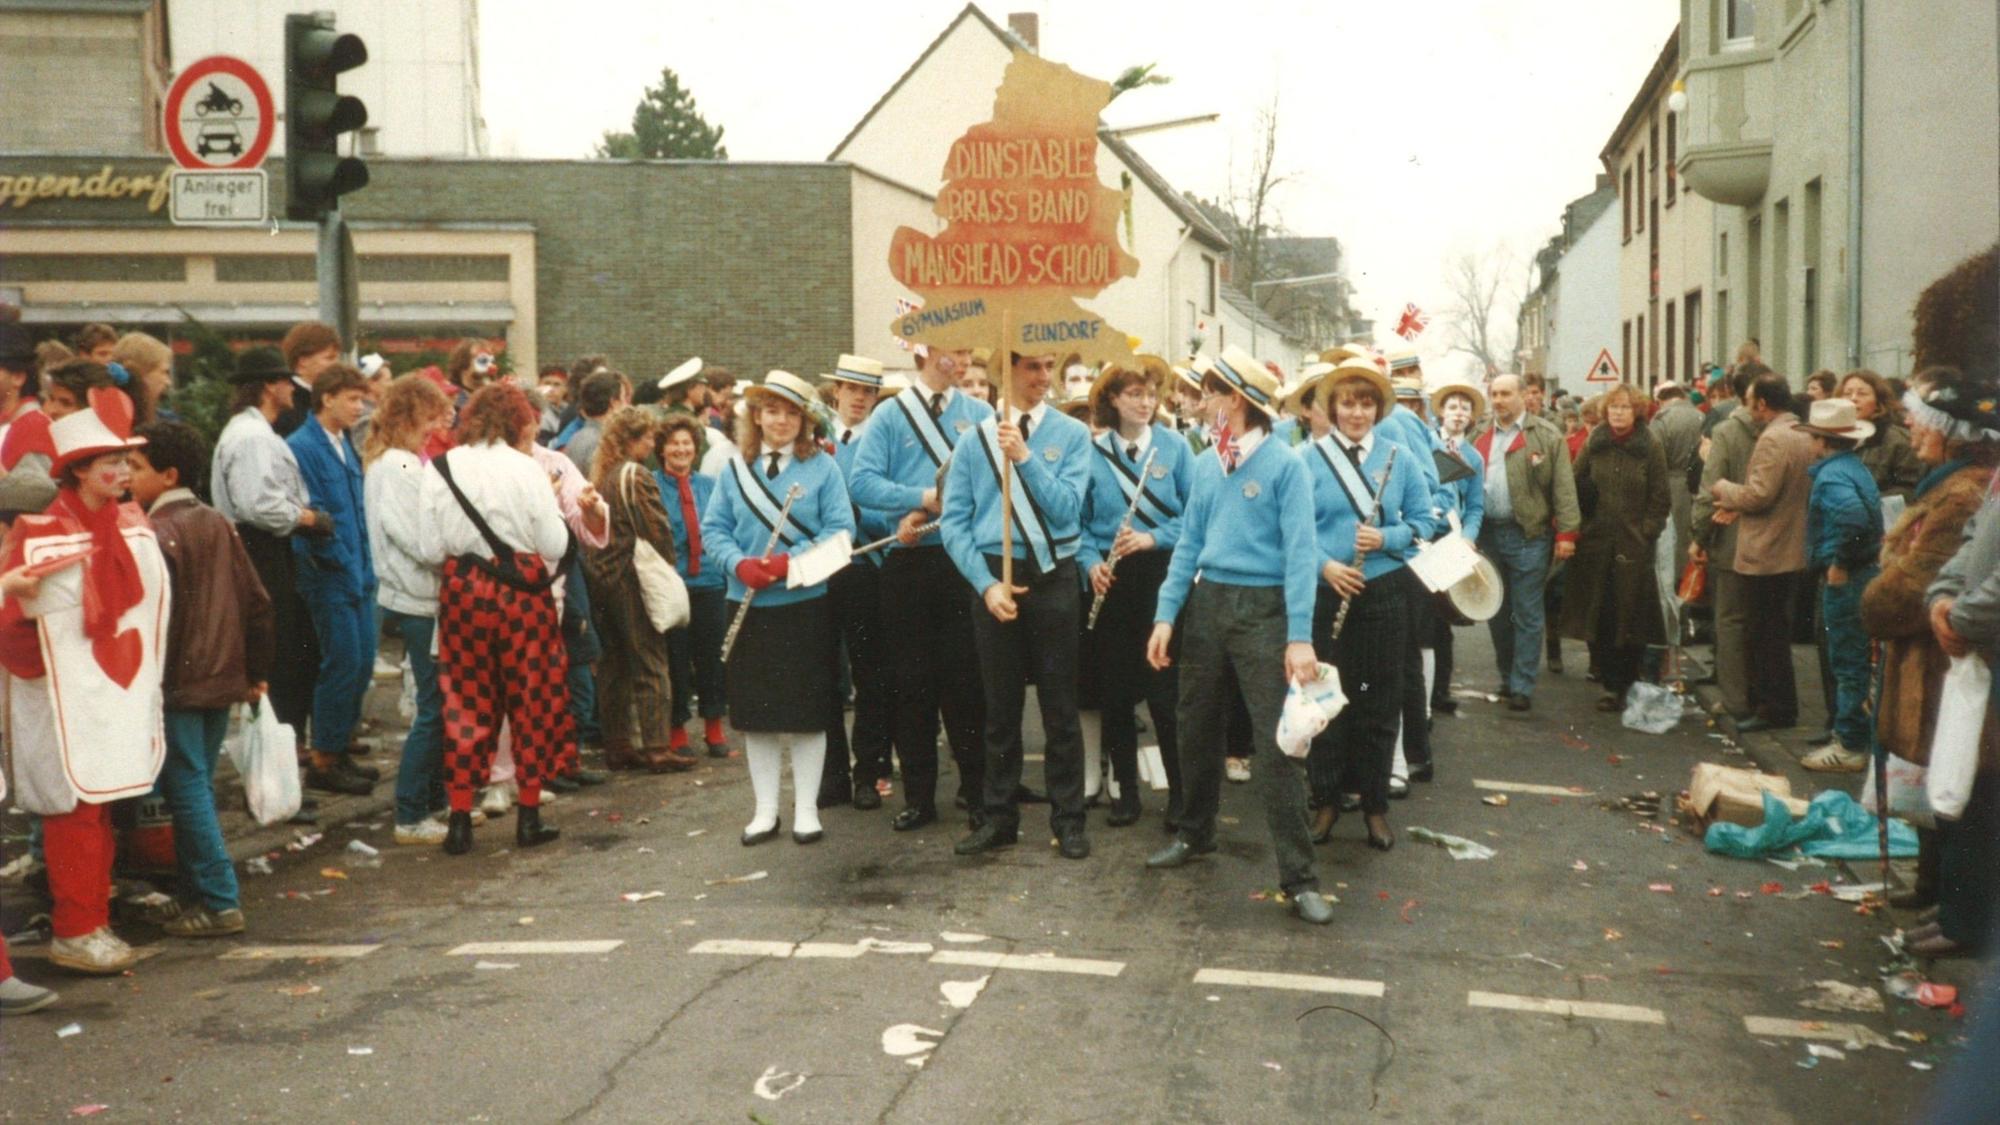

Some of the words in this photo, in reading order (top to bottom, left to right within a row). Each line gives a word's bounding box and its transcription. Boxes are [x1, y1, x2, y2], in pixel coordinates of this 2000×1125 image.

[955, 138, 1096, 180] DUNSTABLE
[183, 178, 253, 198] Anlieger
[948, 188, 1018, 224] BRASS
[1027, 188, 1089, 224] BAND
[204, 201, 233, 216] frei
[904, 242, 1021, 286] MANSHEAD
[1028, 243, 1115, 285] SCHOOL
[902, 298, 986, 336] GYMNASIUM
